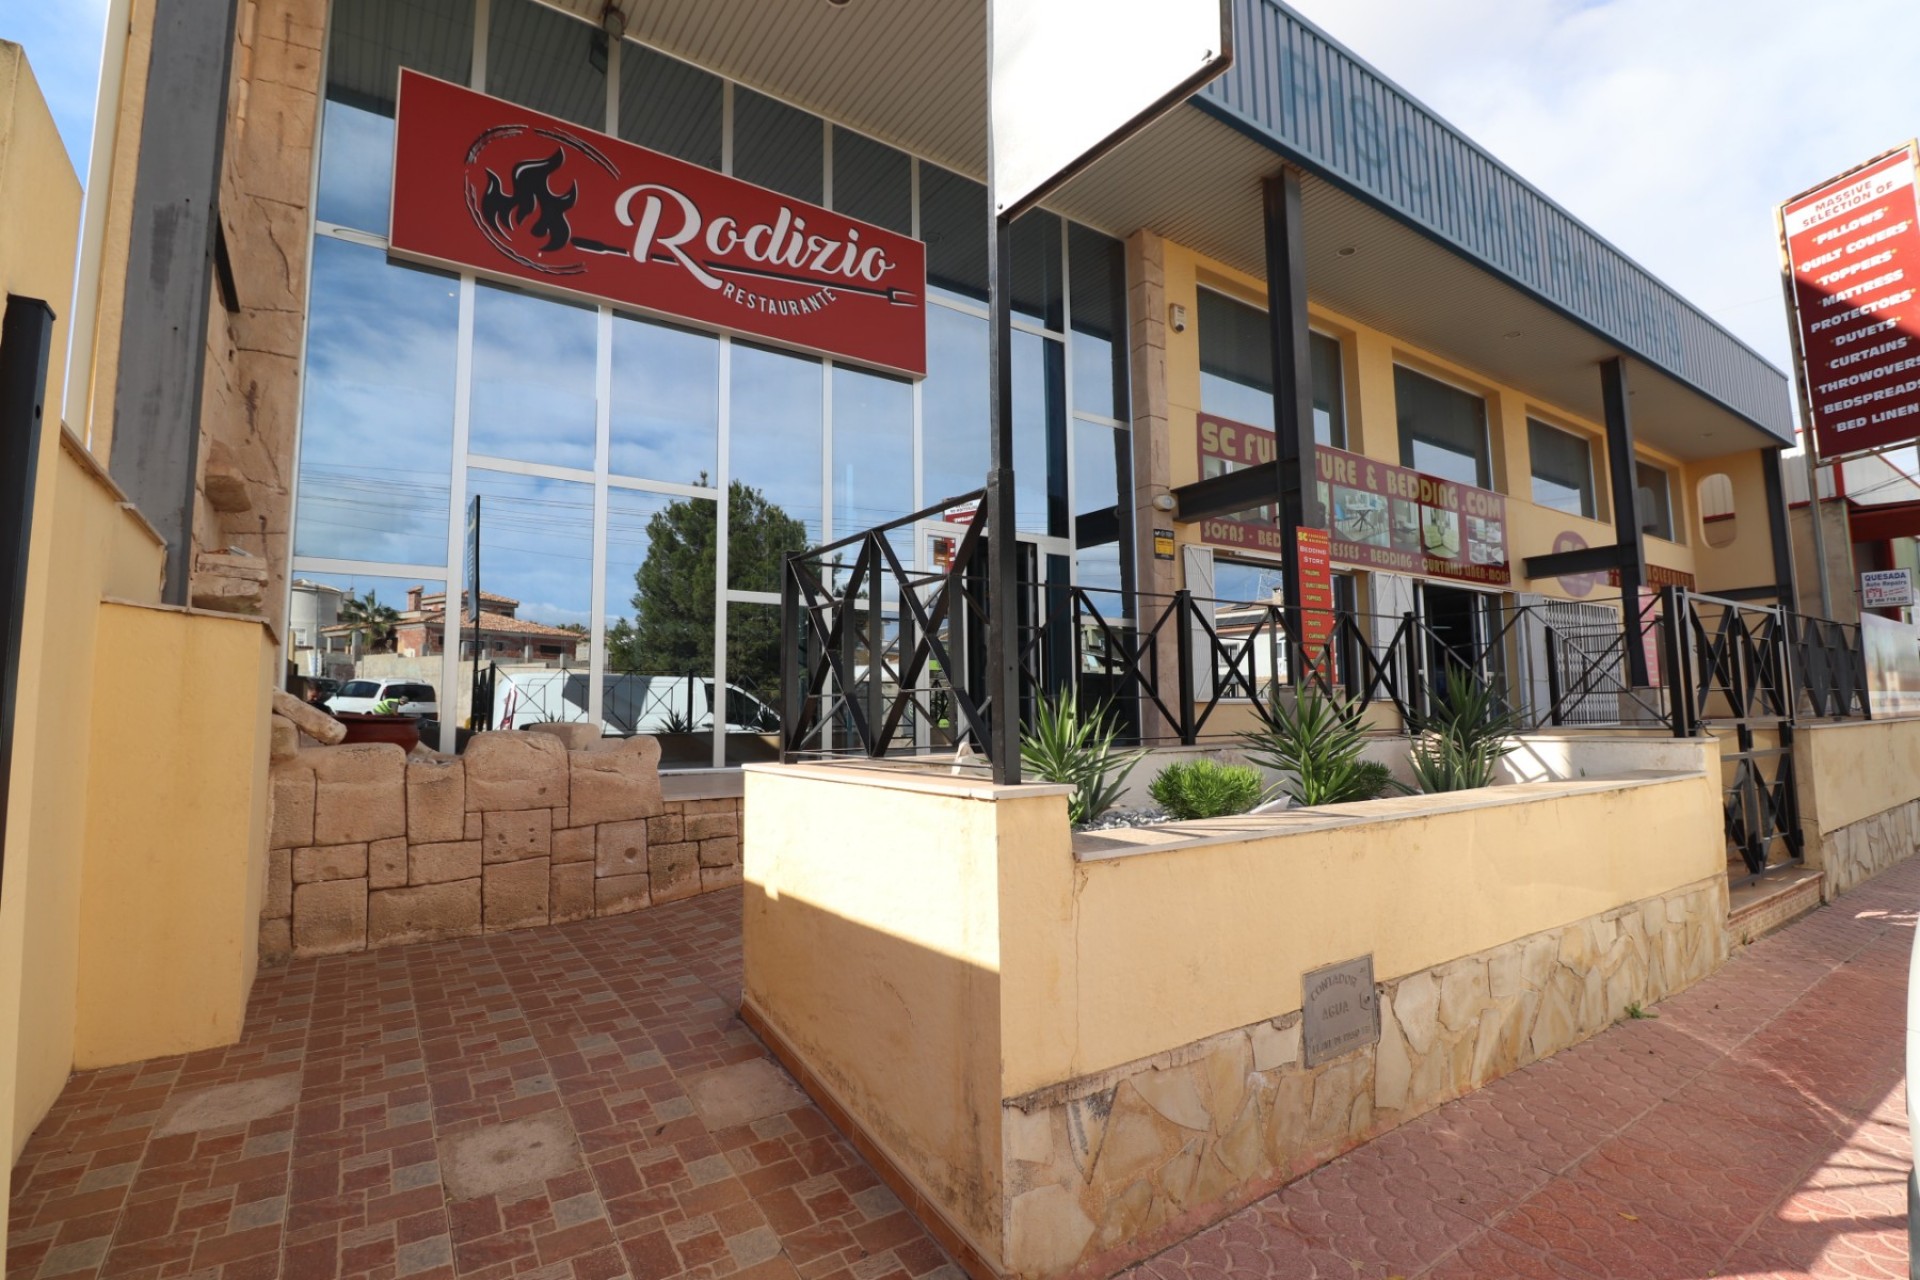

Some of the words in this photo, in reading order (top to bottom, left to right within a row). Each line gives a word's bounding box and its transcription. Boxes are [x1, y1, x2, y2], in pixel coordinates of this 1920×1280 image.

[1803, 192, 1871, 227] SELECTION
[1876, 181, 1893, 195] OF
[1815, 181, 1872, 212] MASSIVE
[614, 183, 896, 290] Rodizio
[1816, 208, 1884, 245] PILLOWS
[1801, 247, 1842, 273] QUILT
[1846, 220, 1908, 254] COVERS
[1819, 249, 1892, 286] TOPPERS
[722, 282, 837, 316] RESTAURANTE
[1822, 268, 1904, 307] MATTRESS
[1811, 289, 1912, 333] PROTECTORS
[1835, 317, 1897, 346] DUVETS
[1830, 336, 1908, 369] CURTAINS
[1836, 416, 1867, 433] BED
[1871, 402, 1920, 424] LINEN
[1202, 421, 1236, 456] SC
[1366, 464, 1378, 490] &
[1386, 470, 1459, 510] BEDDING
[1204, 521, 1244, 543] SOFAS
[1370, 548, 1413, 568] BEDDING
[1865, 572, 1906, 581] QUESADA
[1882, 580, 1907, 588] Repairs
[1311, 973, 1357, 1001] CONTADOR
[1322, 1001, 1349, 1020] AGUA
